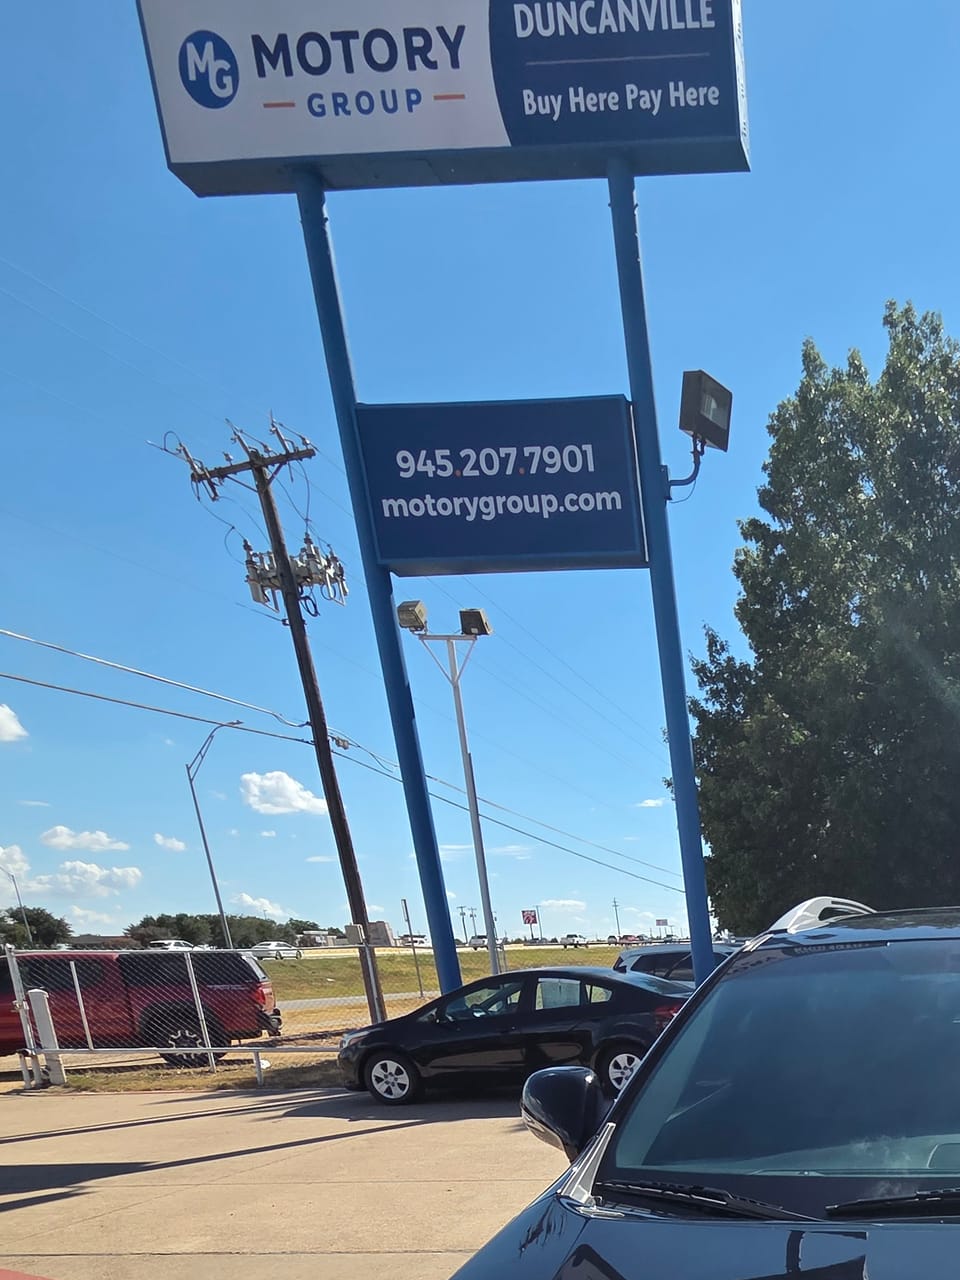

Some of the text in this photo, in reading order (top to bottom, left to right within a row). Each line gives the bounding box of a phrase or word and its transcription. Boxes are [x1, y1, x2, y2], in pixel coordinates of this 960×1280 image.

[513, 0, 715, 38] DUNCANVILLE
[185, 40, 234, 99] MG
[251, 25, 466, 78] MOTORY
[307, 88, 422, 117] GROUP
[522, 80, 720, 121] Buy Here Pay Here
[396, 444, 595, 478] 945.207.7901
[382, 491, 622, 521] motorygroup.com
